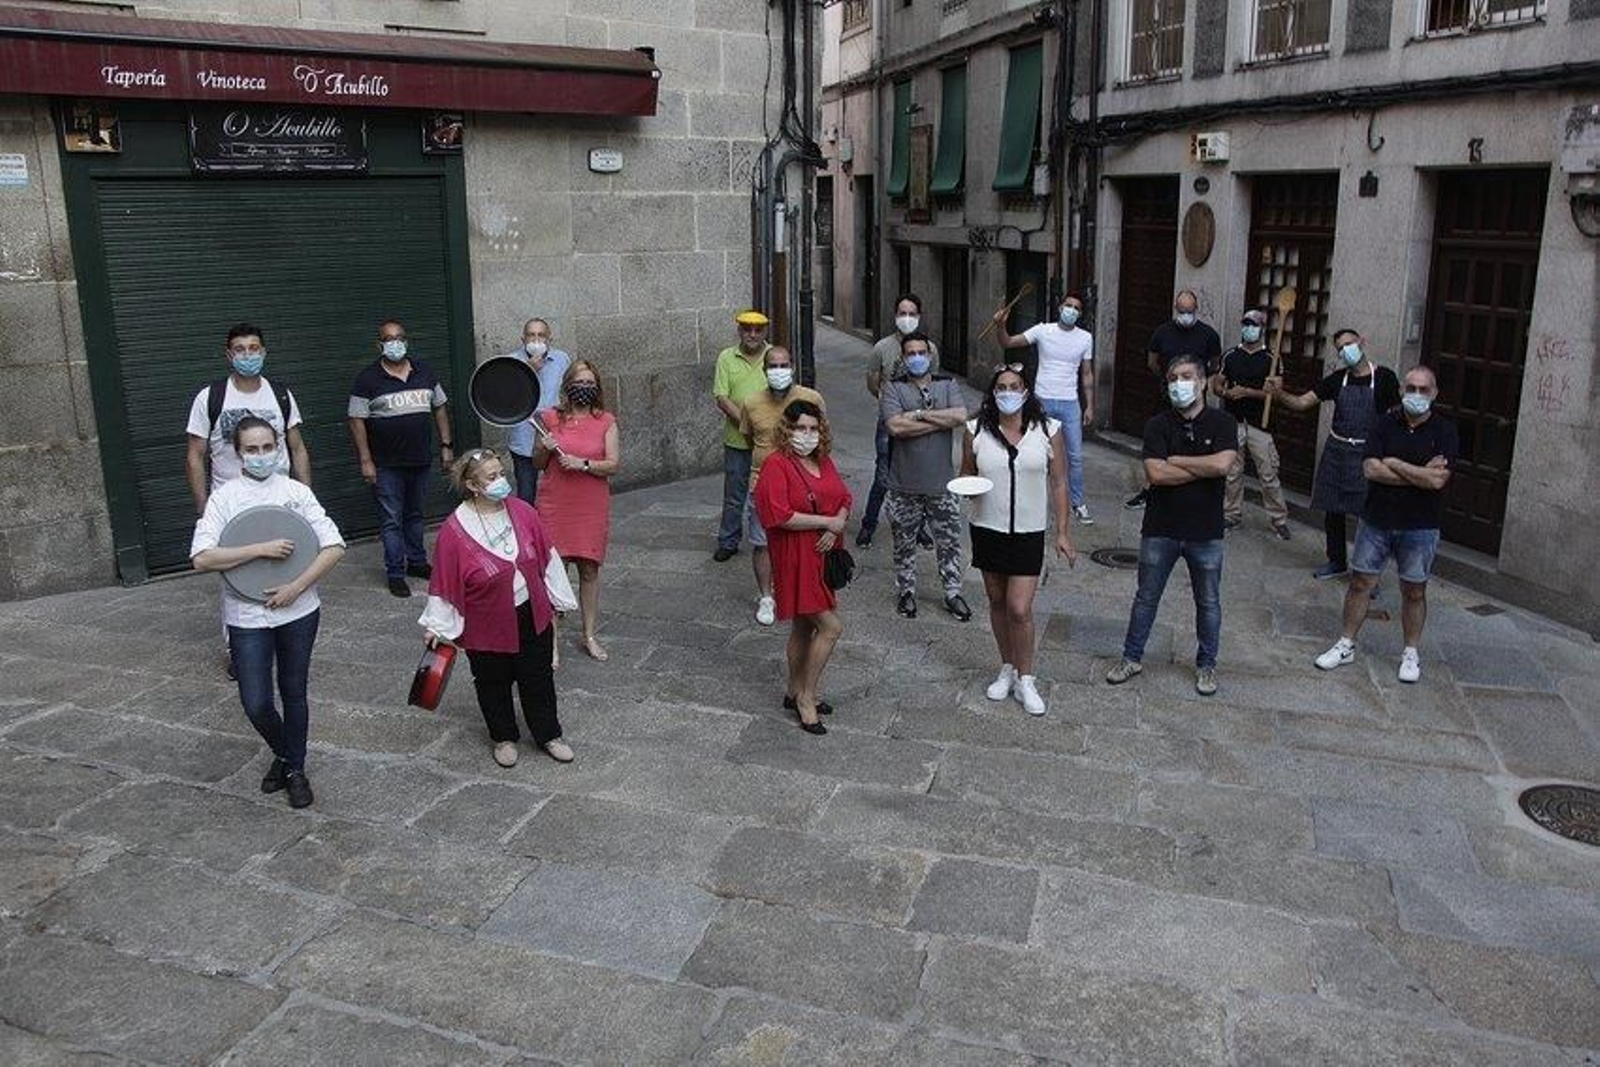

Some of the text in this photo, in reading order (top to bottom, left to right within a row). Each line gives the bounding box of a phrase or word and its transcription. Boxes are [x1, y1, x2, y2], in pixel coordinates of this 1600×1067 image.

[101, 65, 166, 88] Tapería
[197, 69, 267, 89] Vinoteca
[325, 73, 389, 96] Acubillo
[254, 112, 342, 137] Acubillo
